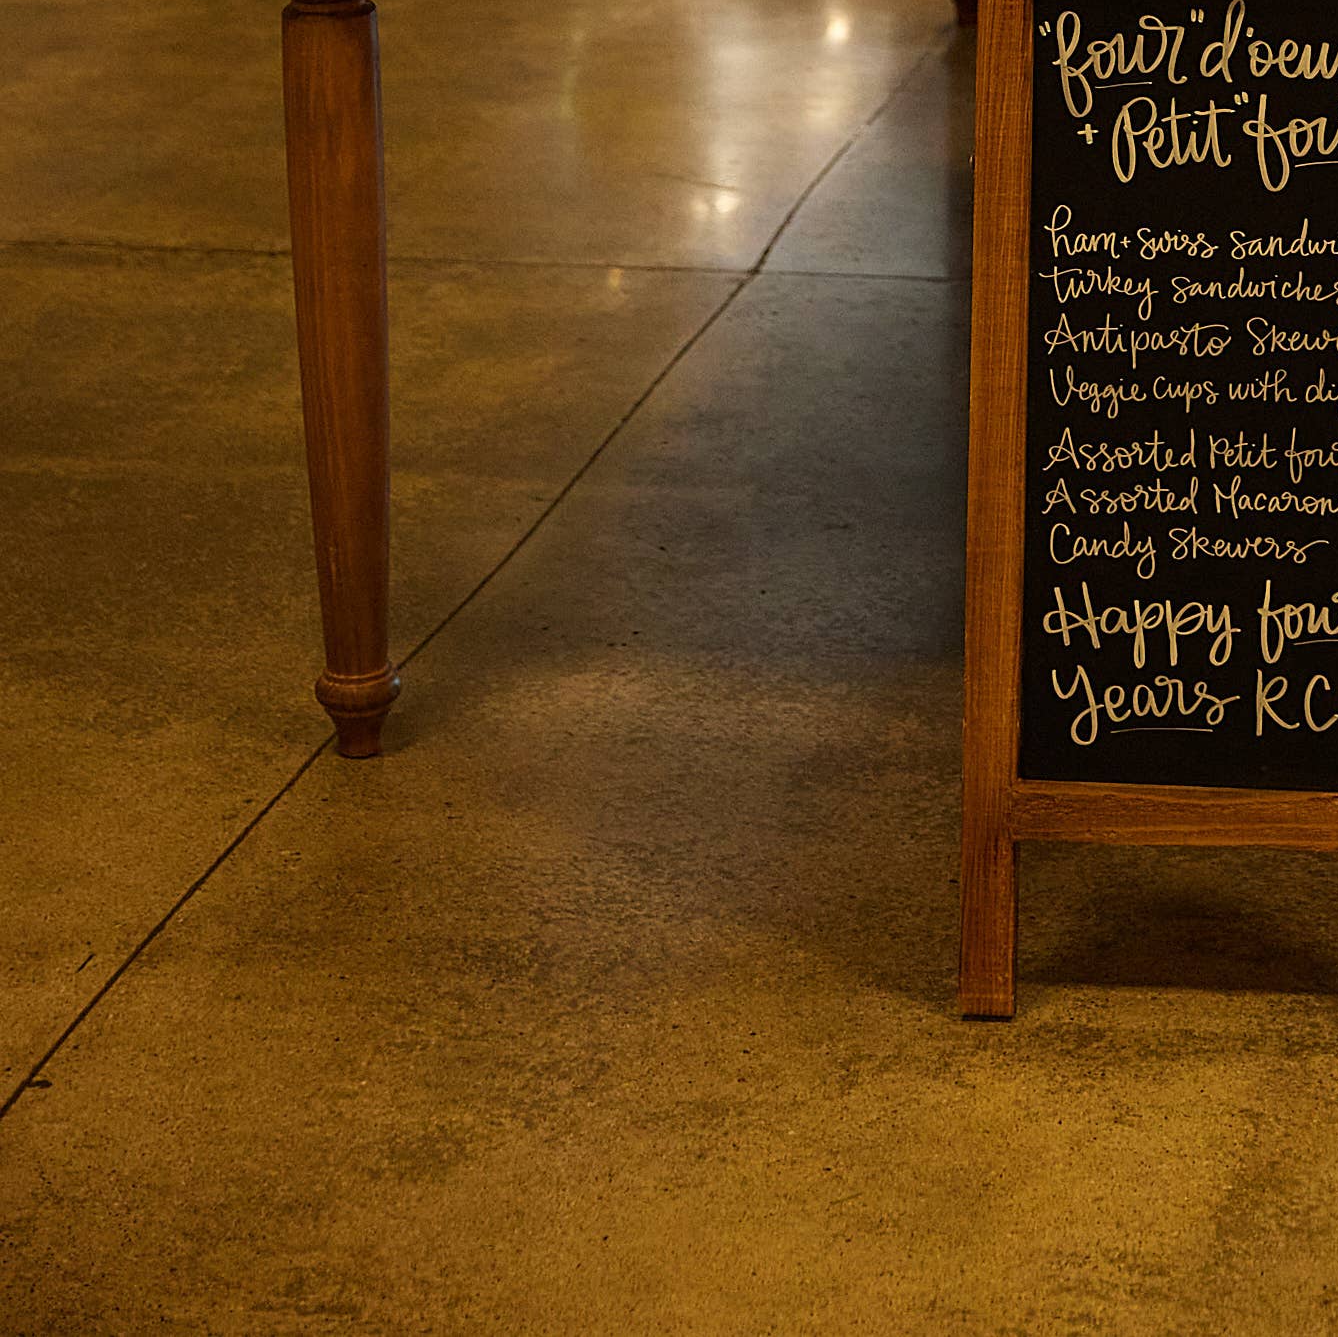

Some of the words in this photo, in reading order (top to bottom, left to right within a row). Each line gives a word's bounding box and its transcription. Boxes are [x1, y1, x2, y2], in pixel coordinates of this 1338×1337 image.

[1039, 266, 1159, 320] turkey
[1044, 313, 1232, 368] Antipasto
[1049, 367, 1147, 419] Veggie
[1228, 370, 1298, 403] with
[1042, 427, 1197, 472] Assorted
[1209, 430, 1277, 471] Petit
[1042, 476, 1197, 515] Assorted
[1049, 521, 1157, 579] Candy
[1042, 581, 1241, 669] Happy
[1052, 664, 1240, 746] Years
